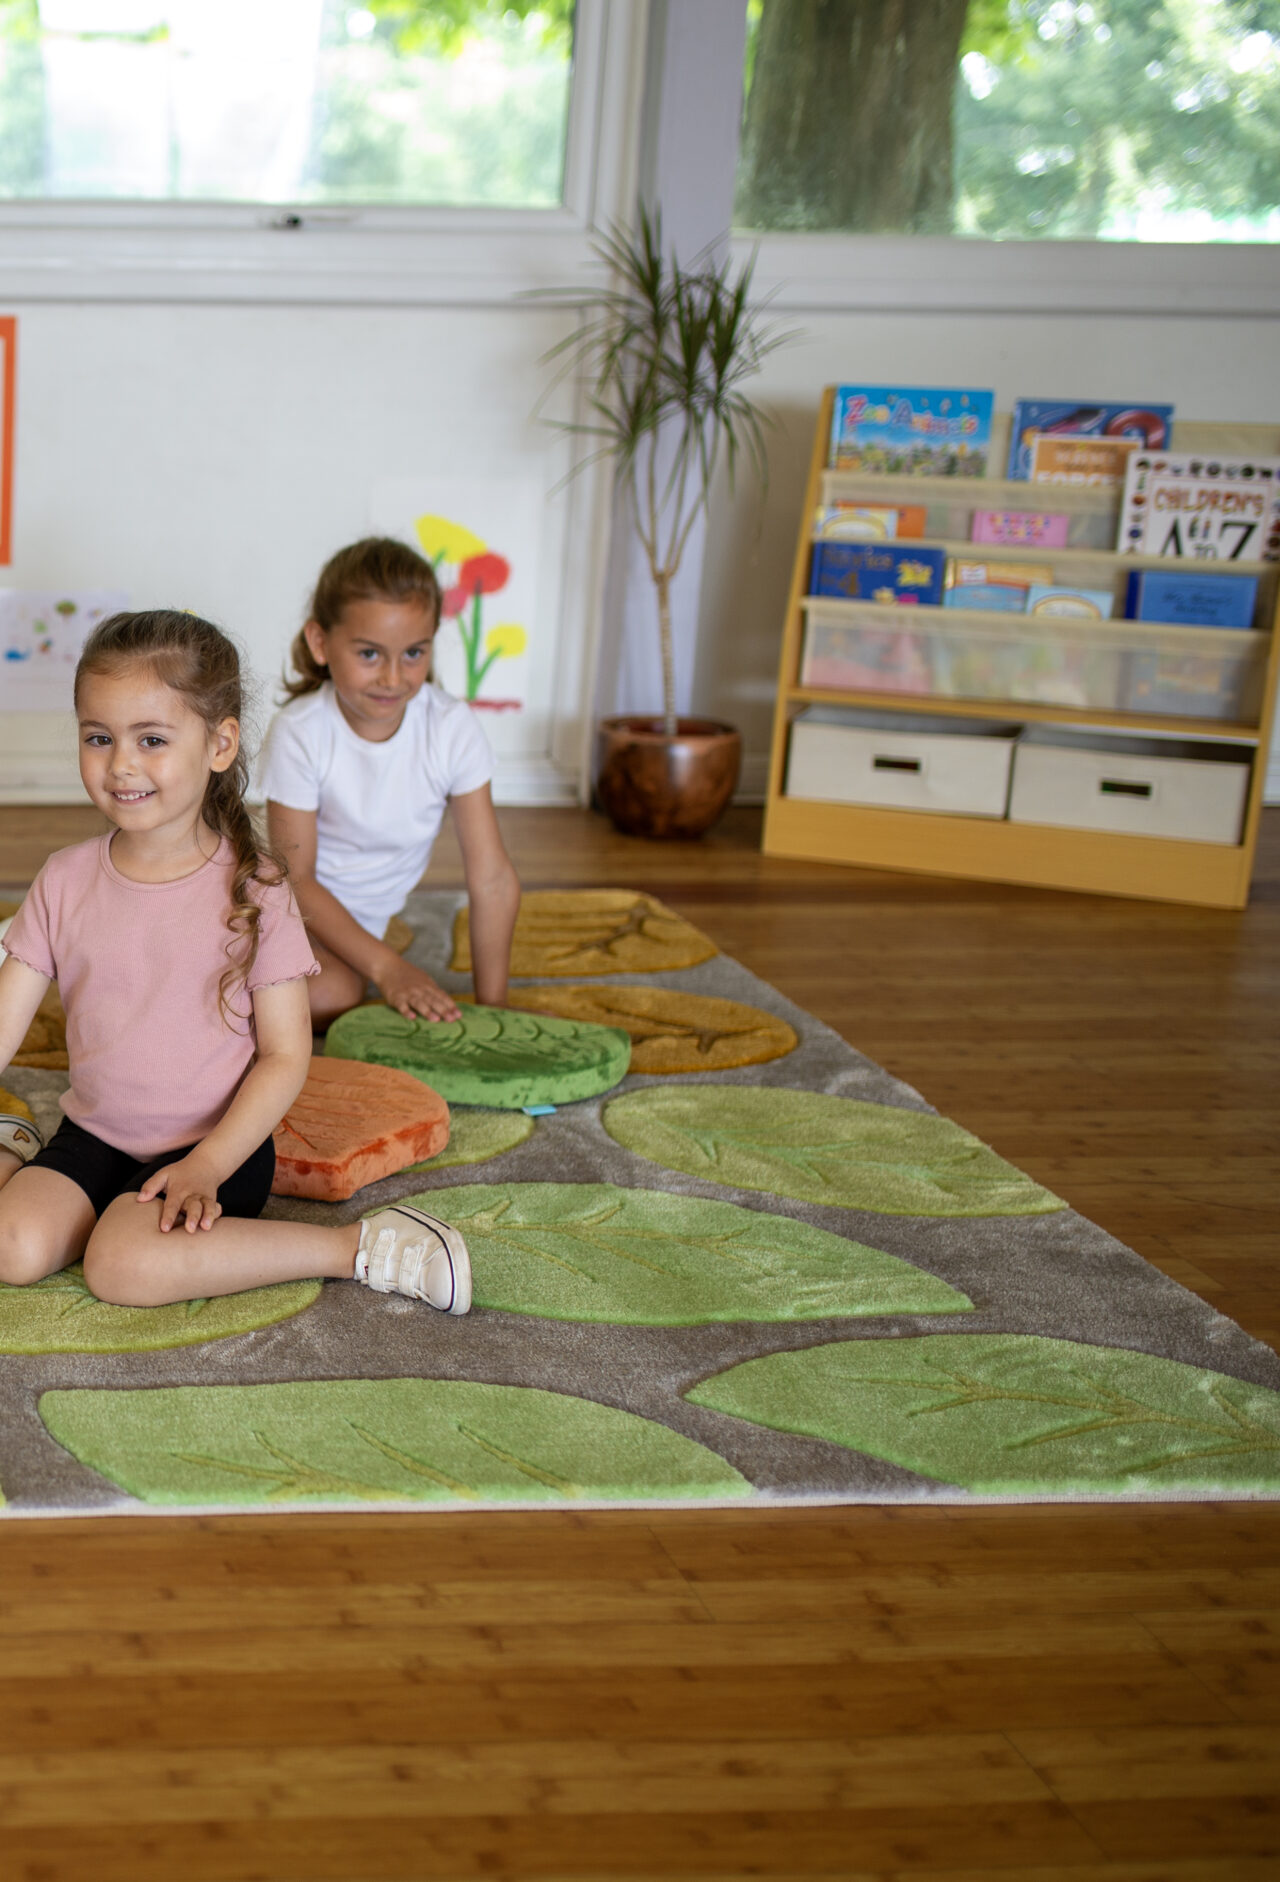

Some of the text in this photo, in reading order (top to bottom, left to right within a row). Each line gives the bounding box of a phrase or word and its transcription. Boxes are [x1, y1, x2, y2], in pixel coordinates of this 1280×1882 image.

[844, 394, 980, 435] Zoo Animals
[1154, 487, 1264, 517] CHILDREN'S
